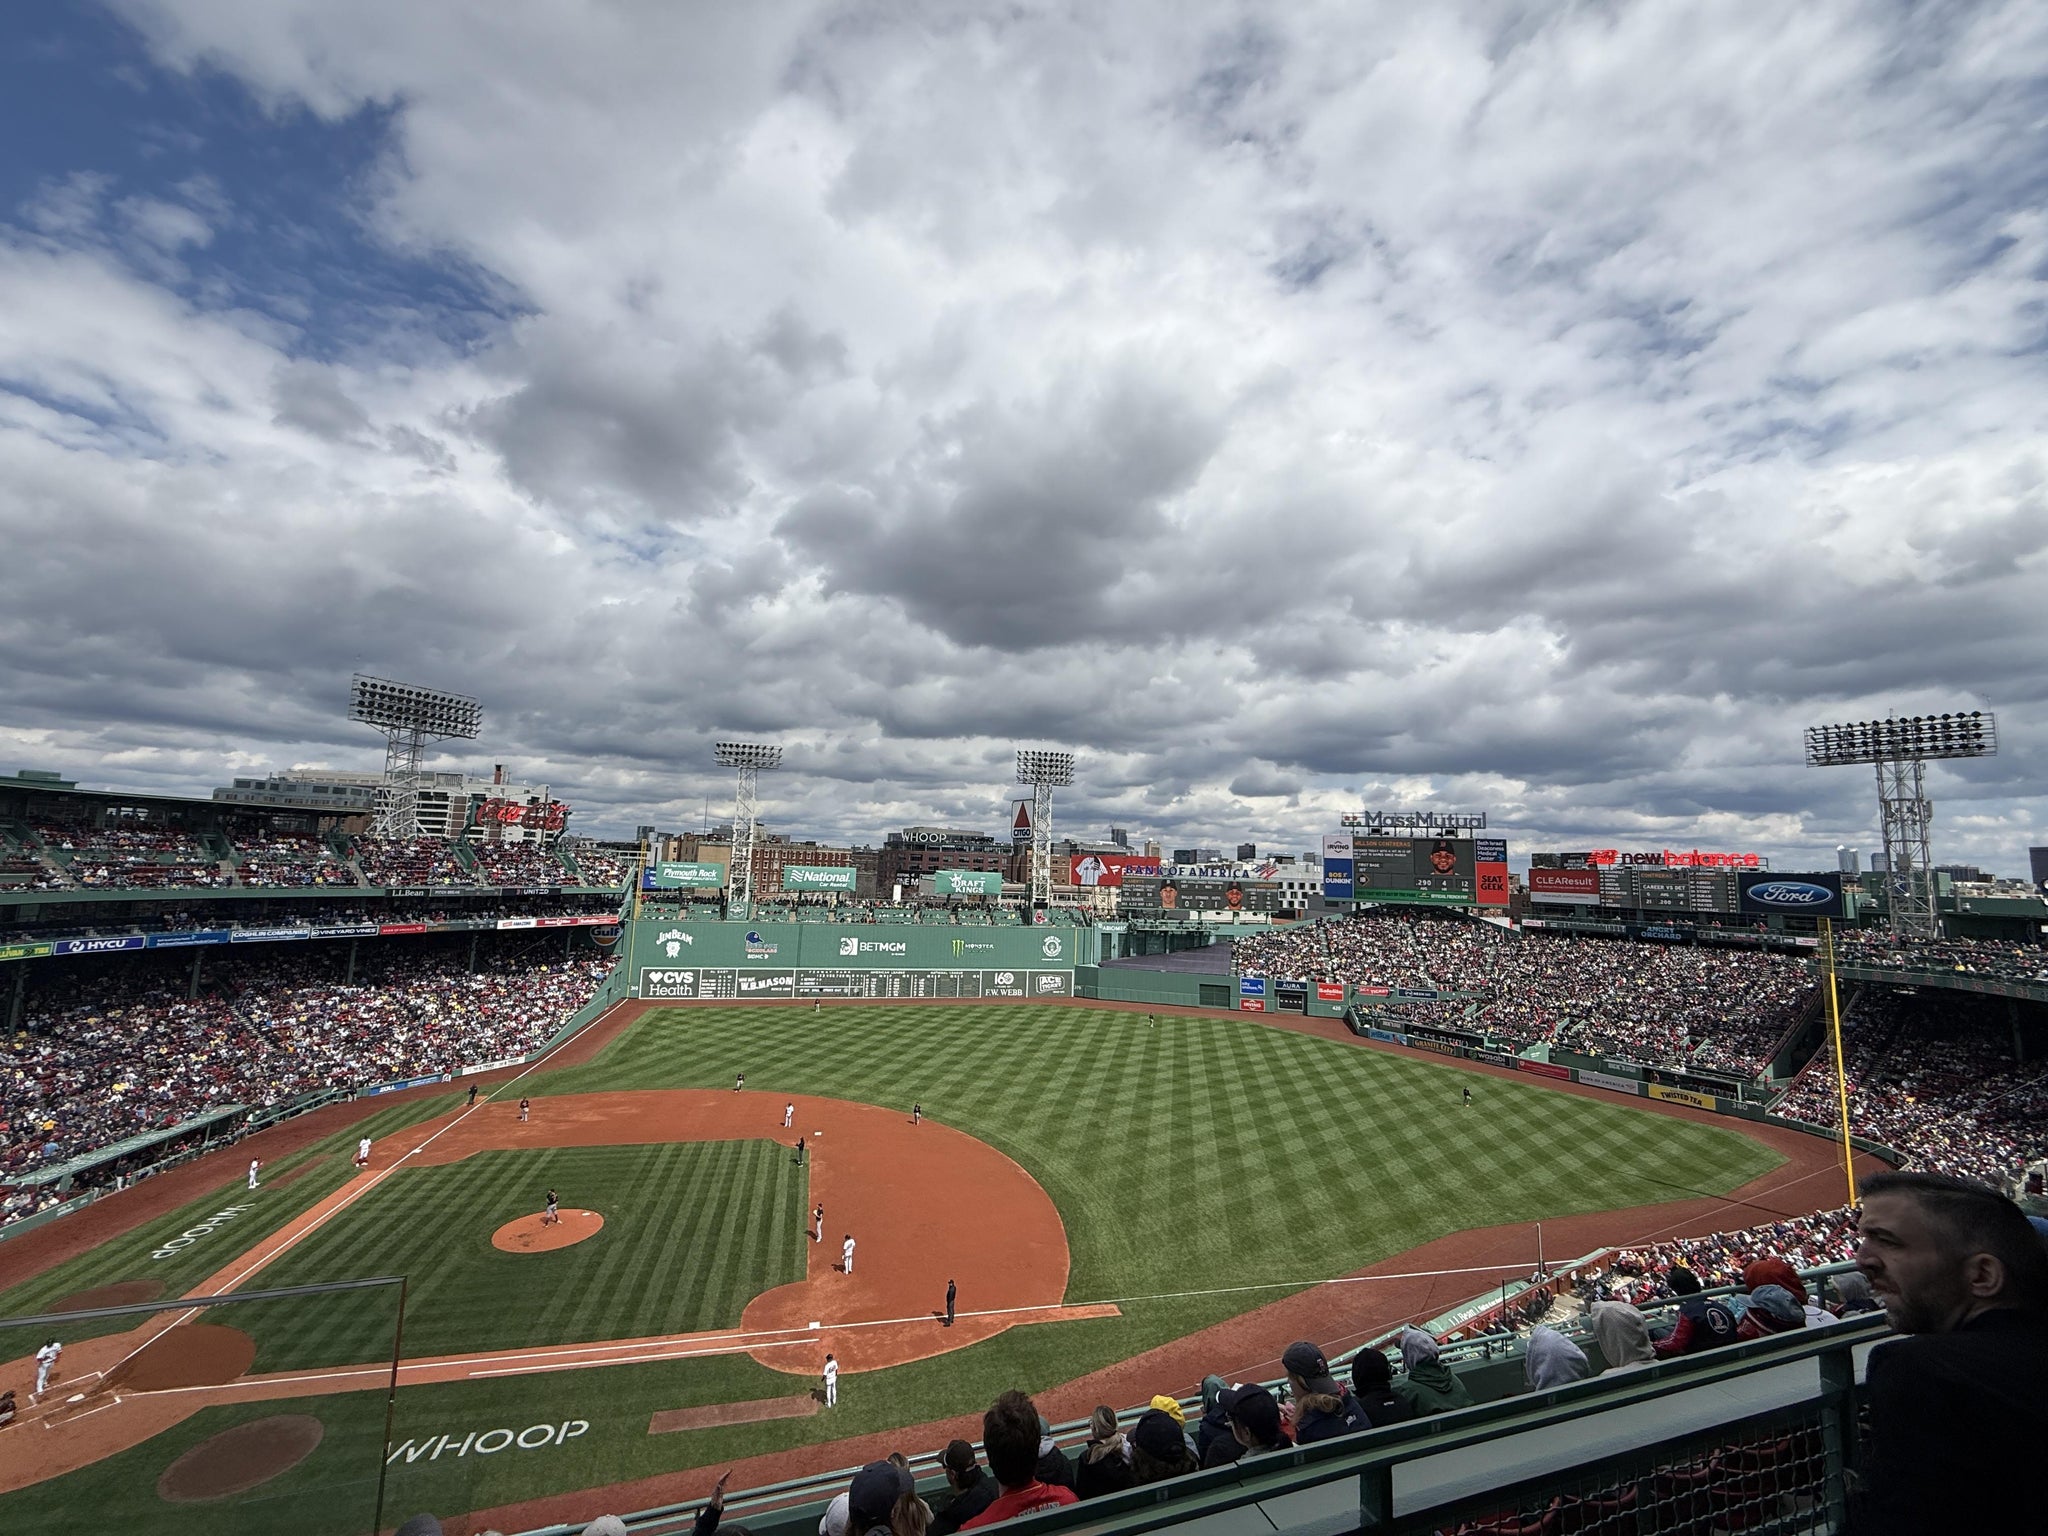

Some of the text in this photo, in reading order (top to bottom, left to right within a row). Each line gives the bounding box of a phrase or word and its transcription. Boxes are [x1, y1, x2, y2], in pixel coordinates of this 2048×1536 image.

[1364, 811, 1486, 828] MassMutual
[901, 832, 947, 843] WHOOP
[1622, 849, 1760, 866] new balance
[664, 868, 697, 878] Plymouth
[698, 869, 717, 877] Rock
[804, 871, 850, 882] National
[1126, 865, 1163, 876] BANK
[1169, 867, 1186, 877] OF
[1189, 867, 1250, 878] AMERICA
[951, 879, 985, 888] DRAFT
[1481, 875, 1503, 883] SEAT
[1535, 876, 1593, 886] CLEAResult
[1480, 883, 1504, 891] GEEK
[1763, 885, 1814, 902] Ford
[592, 926, 620, 937] Gulf
[656, 929, 693, 945] JIM BEAM
[1641, 931, 1682, 940] ORCHARD
[87, 939, 126, 950] HYCU
[860, 942, 906, 952] BETMGM
[663, 971, 694, 984] CVS
[994, 972, 1014, 985] 160
[1041, 976, 1062, 984] ACE
[649, 984, 693, 996] Health
[1001, 988, 1023, 996] WEBB
[1414, 1039, 1439, 1050] GRANITE
[1478, 1052, 1506, 1062] wasabi
[1661, 1091, 1702, 1106] TWISTED TEA
[152, 1203, 256, 1259] WHOOP
[386, 1420, 590, 1466] WHOOP
